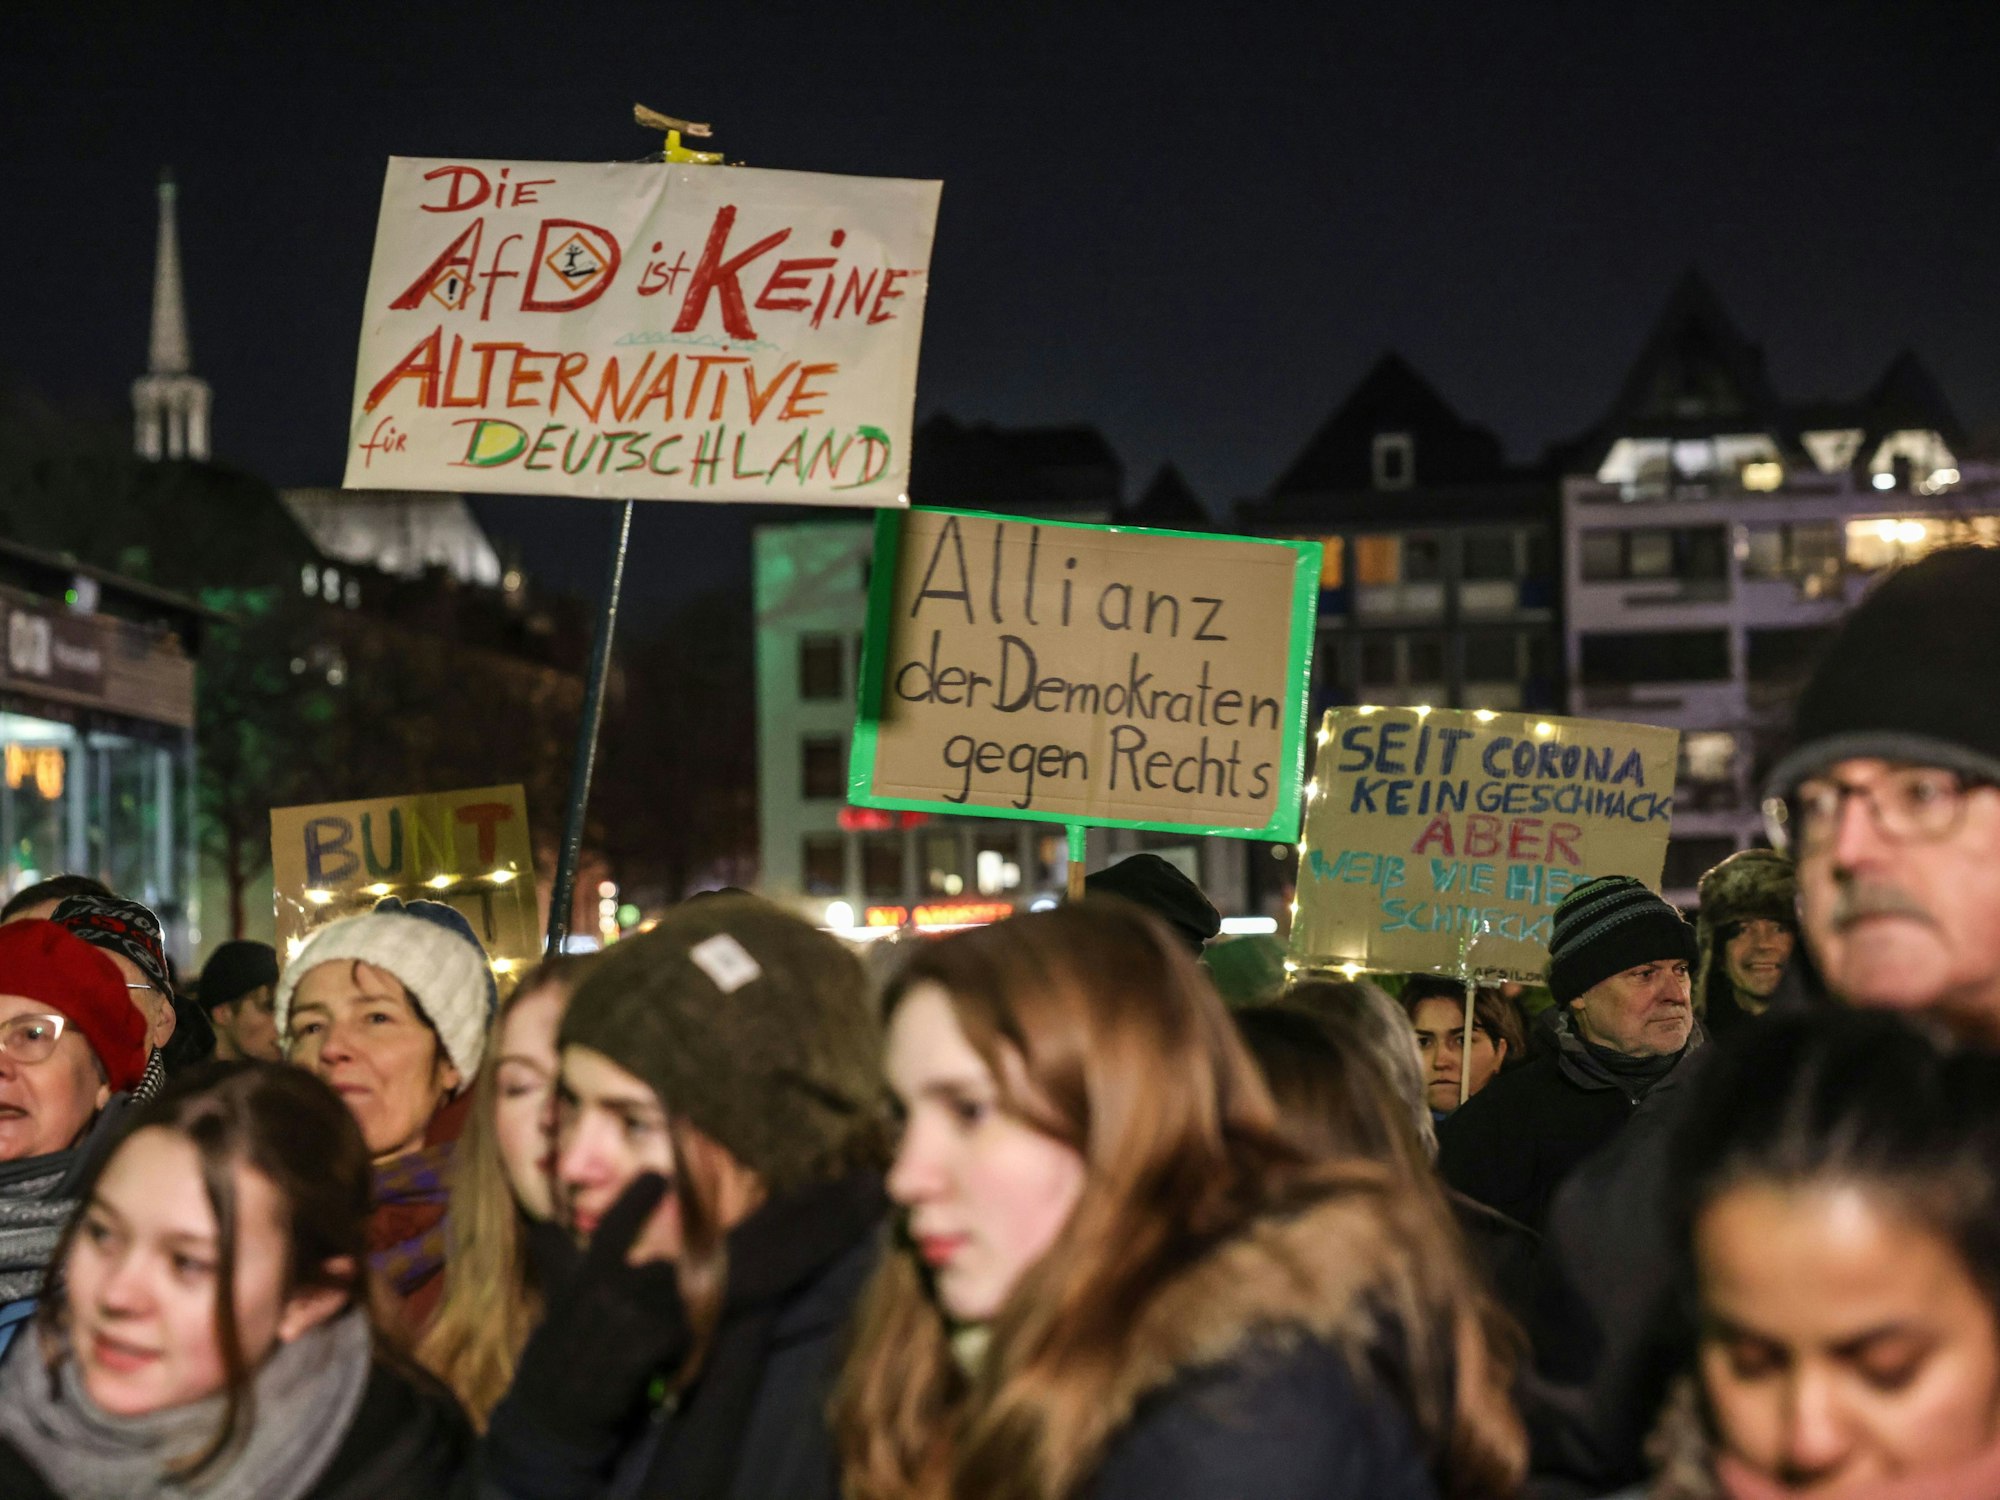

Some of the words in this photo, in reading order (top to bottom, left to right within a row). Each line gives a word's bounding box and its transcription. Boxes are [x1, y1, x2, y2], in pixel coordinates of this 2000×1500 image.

[388, 216, 622, 321] AfD
[637, 241, 691, 296] ist
[448, 417, 891, 490] DEUTSCHLAND
[911, 515, 1228, 641] Allianz
[896, 629, 992, 708] der
[992, 634, 1280, 730] Demokraten
[943, 734, 1088, 810] gegen
[1110, 725, 1272, 800] Rechts
[1338, 722, 1475, 776] SEIT
[1482, 736, 1645, 788] CORONA
[1350, 776, 1469, 816] KEIN
[1476, 781, 1672, 823] GESCHMACK
[1410, 812, 1583, 866] ABER
[303, 802, 514, 888] BUNT
[1429, 857, 1496, 896] WIE
